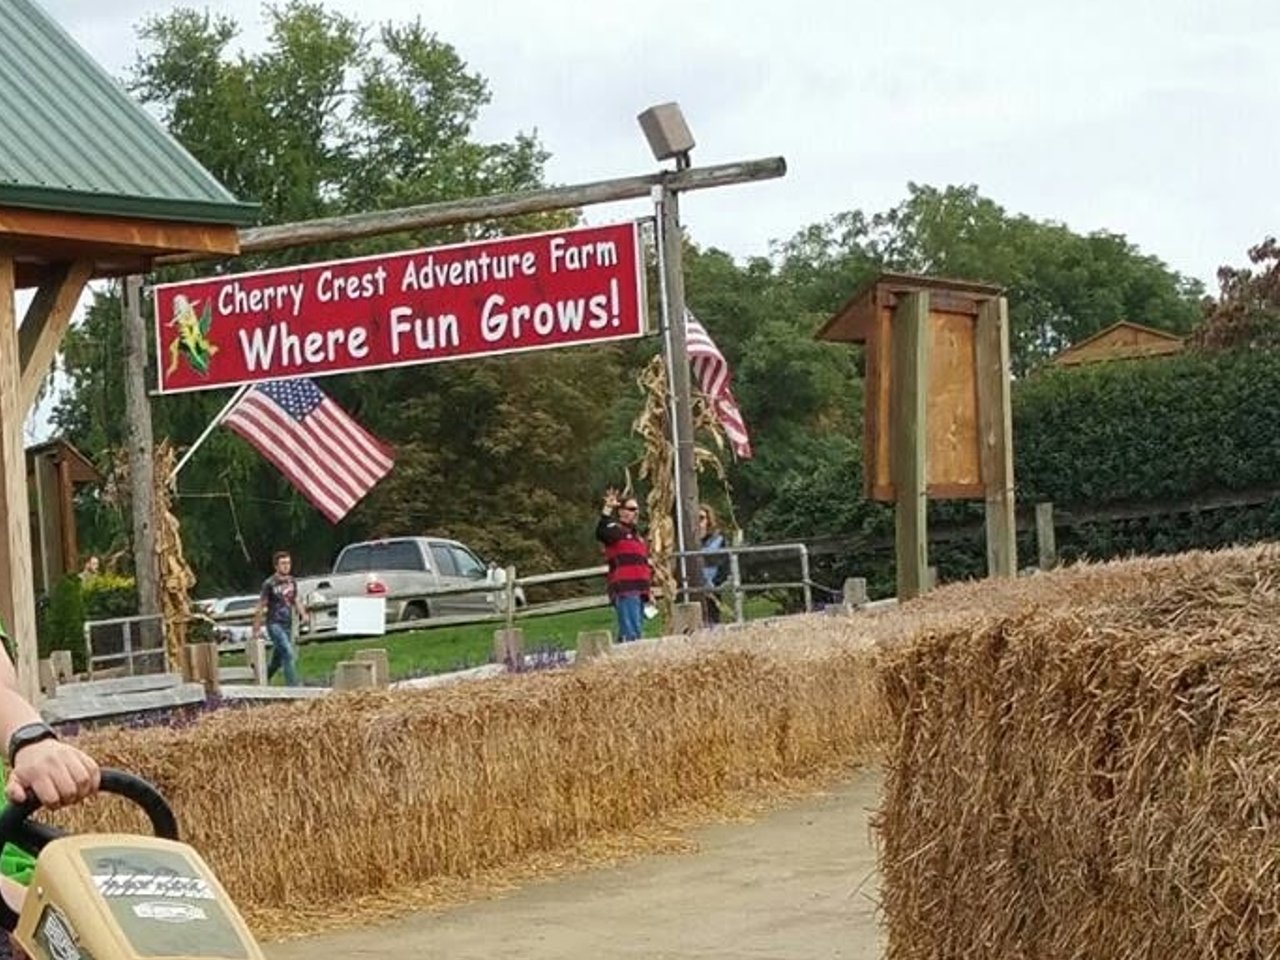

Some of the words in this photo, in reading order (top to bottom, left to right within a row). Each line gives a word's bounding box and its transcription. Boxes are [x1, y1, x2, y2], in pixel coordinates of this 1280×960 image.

[217, 281, 305, 316] Cherry
[317, 265, 387, 302] Crest
[401, 251, 537, 292] Adventure
[549, 240, 618, 275] Farm
[238, 321, 369, 372] Where
[390, 306, 461, 355] Fun
[480, 277, 621, 342] Grows!
